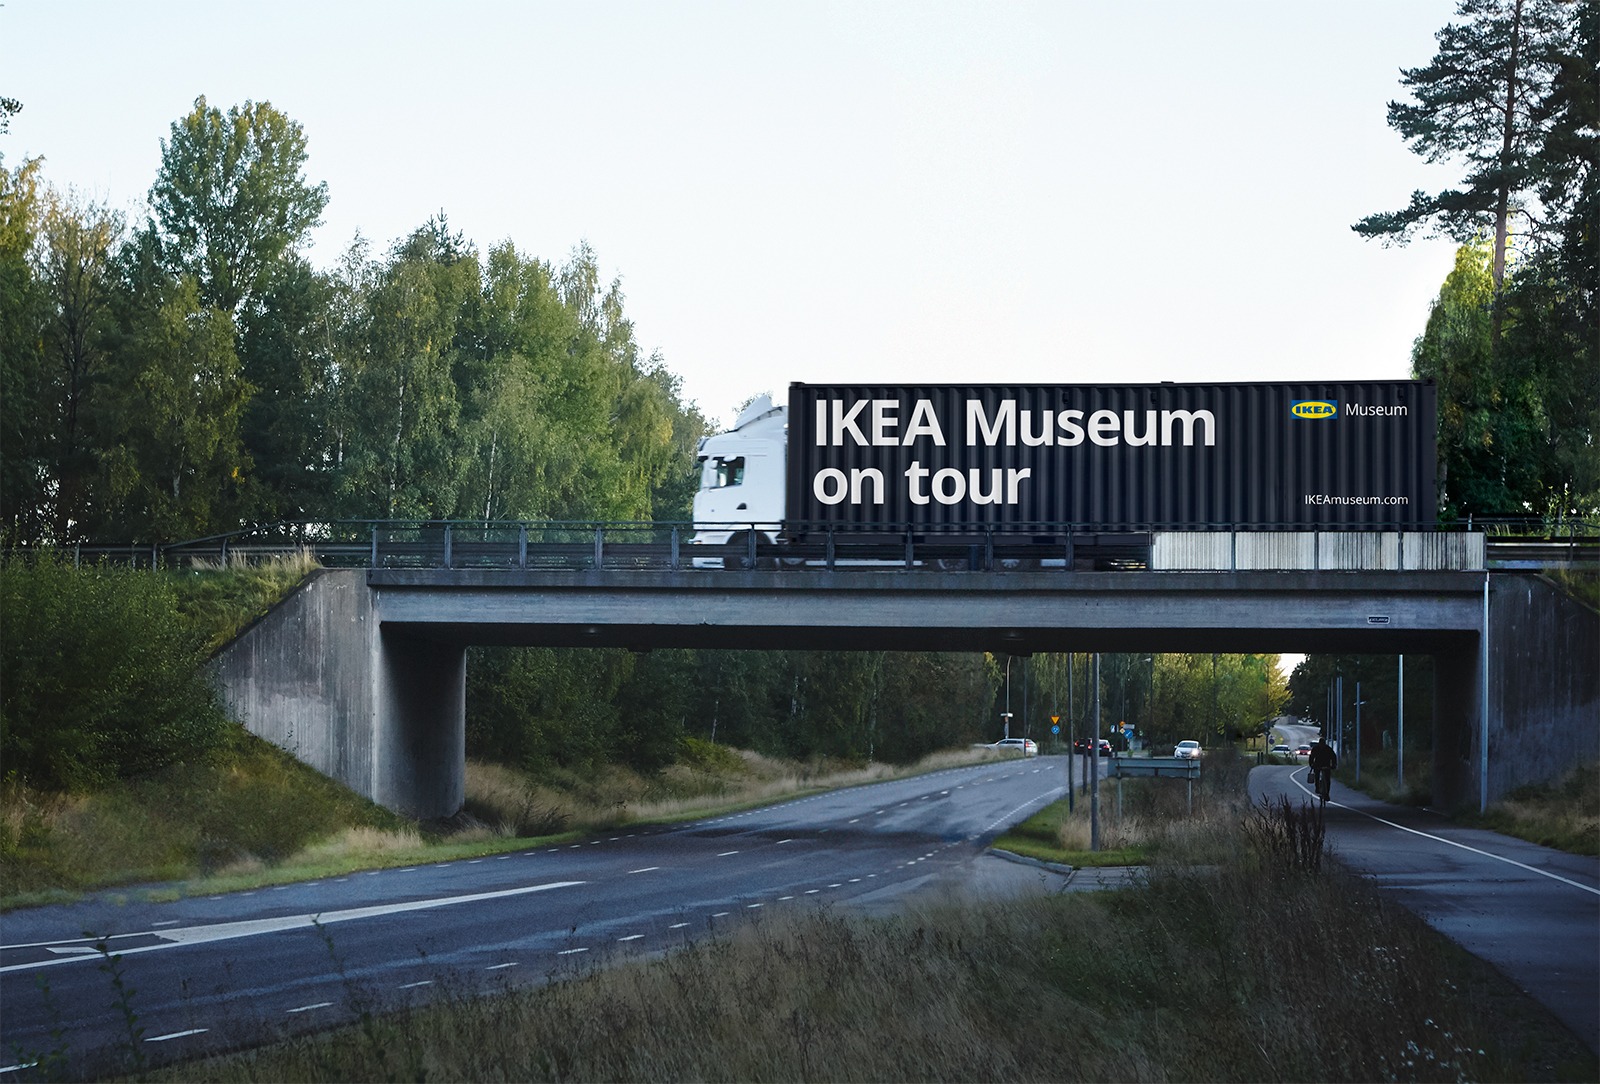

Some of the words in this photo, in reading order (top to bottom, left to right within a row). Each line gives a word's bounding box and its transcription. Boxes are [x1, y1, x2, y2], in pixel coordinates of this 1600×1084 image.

[815, 399, 947, 447] IKEA
[966, 399, 1216, 447] Museum
[1294, 405, 1334, 414] IKEA
[1345, 403, 1408, 416] Museum
[813, 467, 885, 505] on
[904, 460, 1032, 505] tour
[1304, 494, 1409, 505] IKEAmuseum.com
